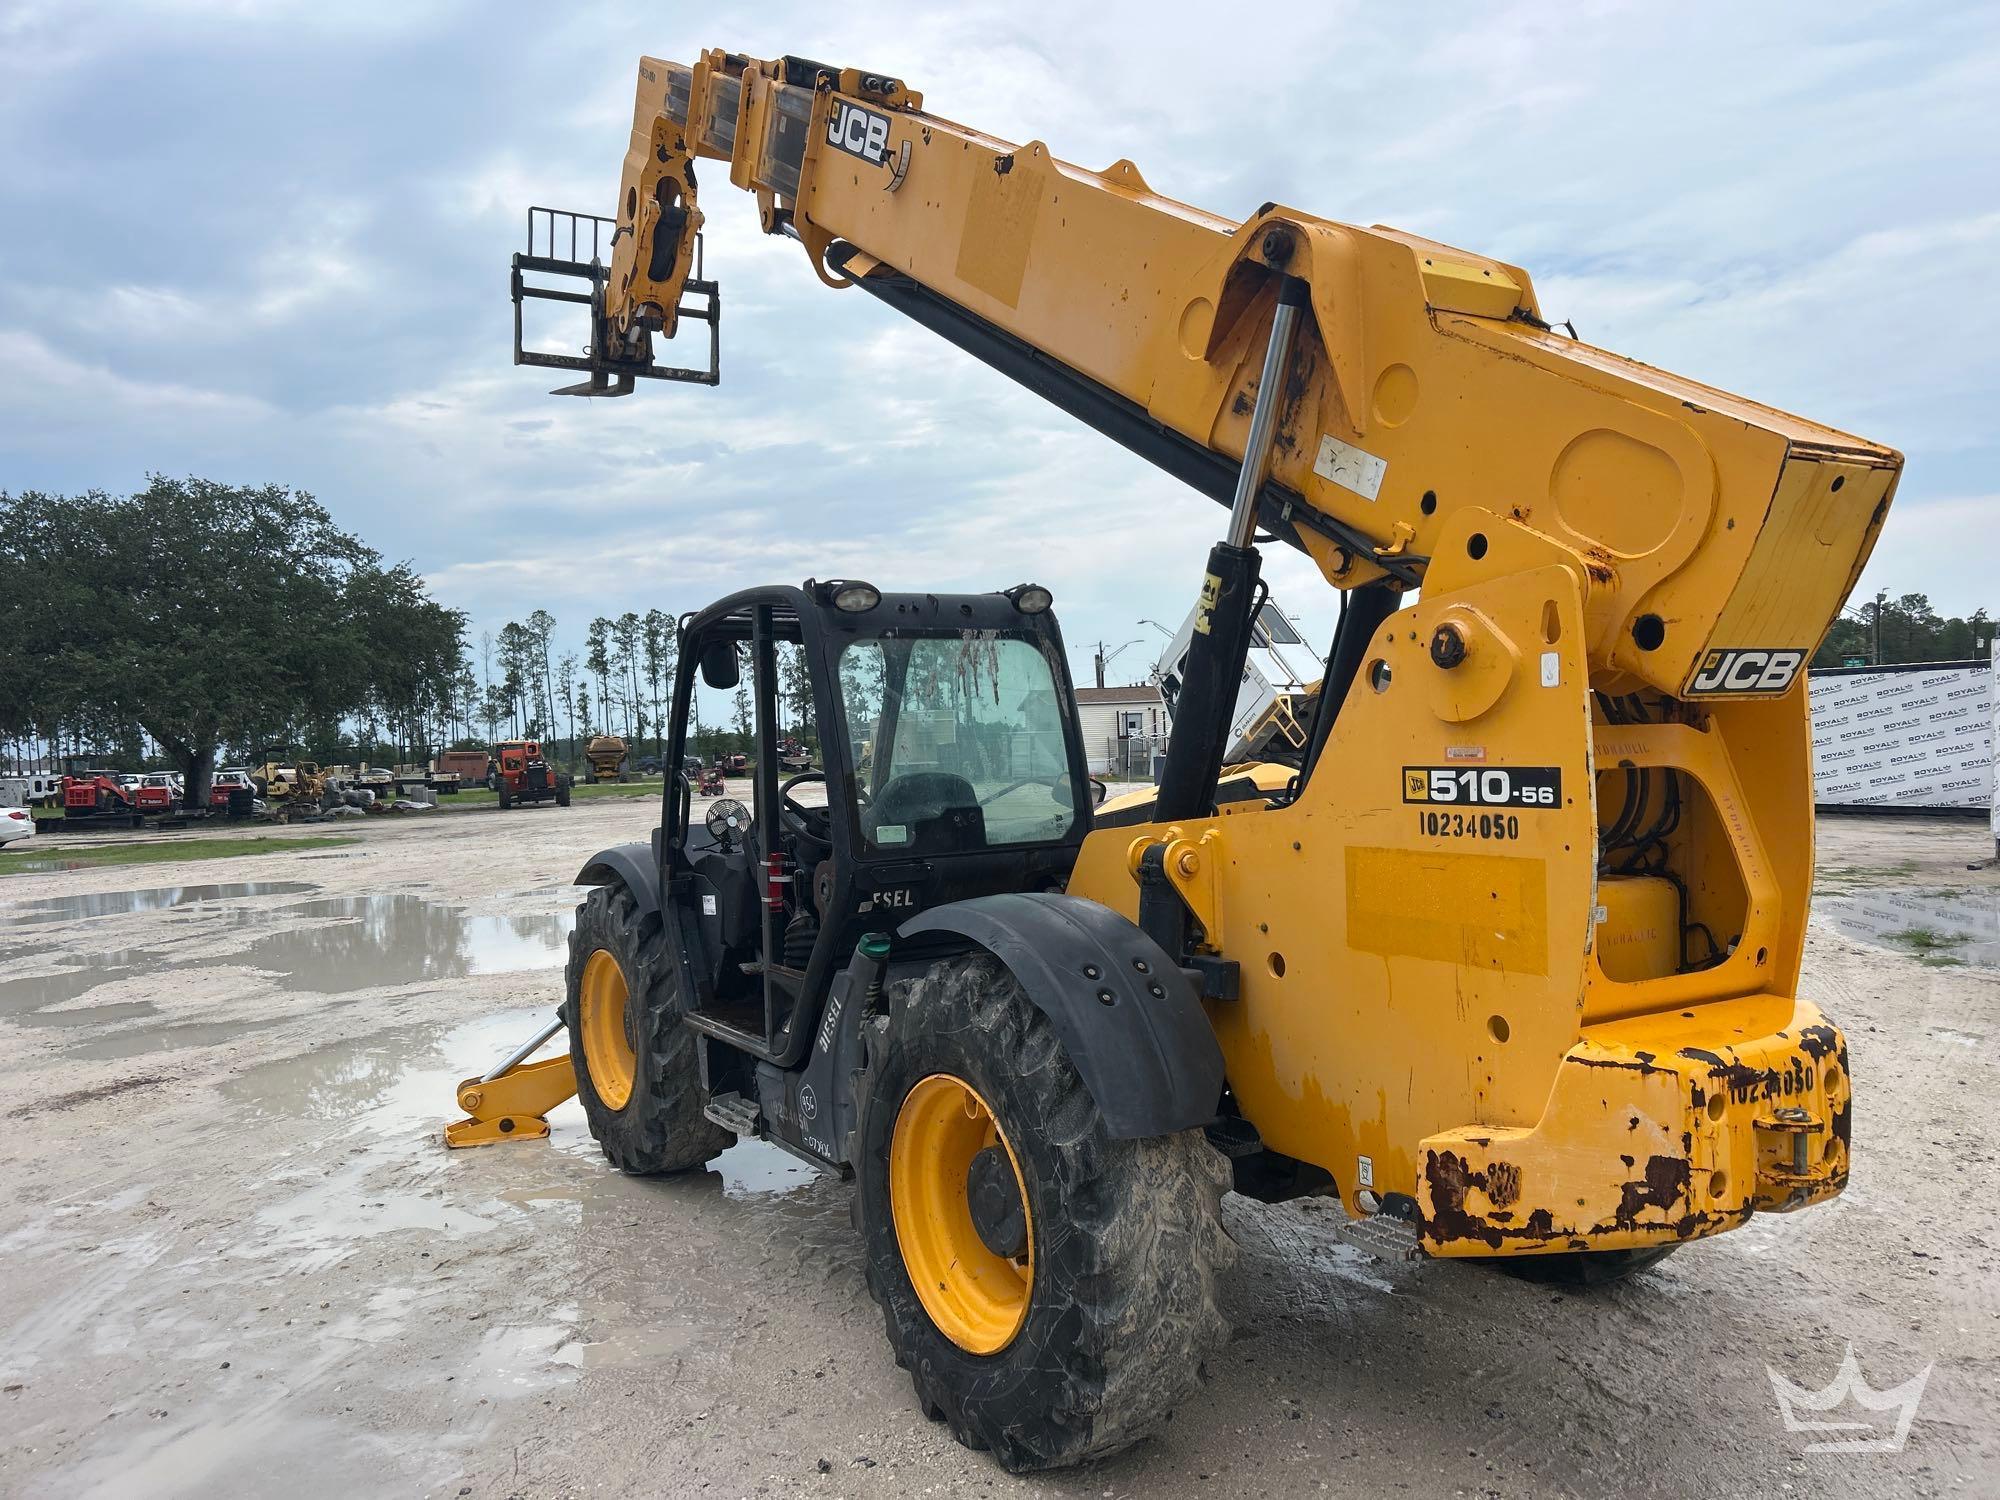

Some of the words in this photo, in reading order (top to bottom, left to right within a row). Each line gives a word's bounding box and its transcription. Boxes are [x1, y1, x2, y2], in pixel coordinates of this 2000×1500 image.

[828, 105, 888, 161] JCB
[1695, 652, 1801, 690] JCB
[1850, 676, 1877, 685] ROYAL
[1922, 675, 1951, 685] ROYAL
[1809, 687, 1834, 695] ROYAL
[1877, 687, 1905, 696] ROYAL
[1947, 687, 1978, 697] ROYAL
[1834, 697, 1860, 706] ROYAL
[1901, 698, 1930, 708] ROYAL
[1857, 708, 1884, 718] ROYAL
[1929, 710, 1959, 720] ROYAL
[1815, 718, 1840, 727] ROYAL
[1884, 719, 1912, 729] ROYAL
[1955, 722, 1985, 732] ROYAL
[1840, 729, 1867, 738] ROYAL
[1908, 732, 1937, 742] ROYAL
[1863, 742, 1891, 751] ROYAL
[1936, 744, 1966, 754] ROYAL
[1821, 751, 1847, 759] ROYAL
[1890, 754, 1918, 763] ROYAL
[1846, 763, 1874, 771] ROYAL
[1961, 758, 1991, 767] ROYAL
[1914, 766, 1943, 776] ROYAL
[1869, 776, 1897, 784] ROYAL
[1942, 779, 1972, 789] ROYAL
[1430, 770, 1554, 803] 510-56
[1826, 783, 1853, 792] ROYAL
[1896, 788, 1925, 796] ROYAL
[1852, 796, 1880, 804] ROYAL
[1419, 811, 1519, 840] 10234050
